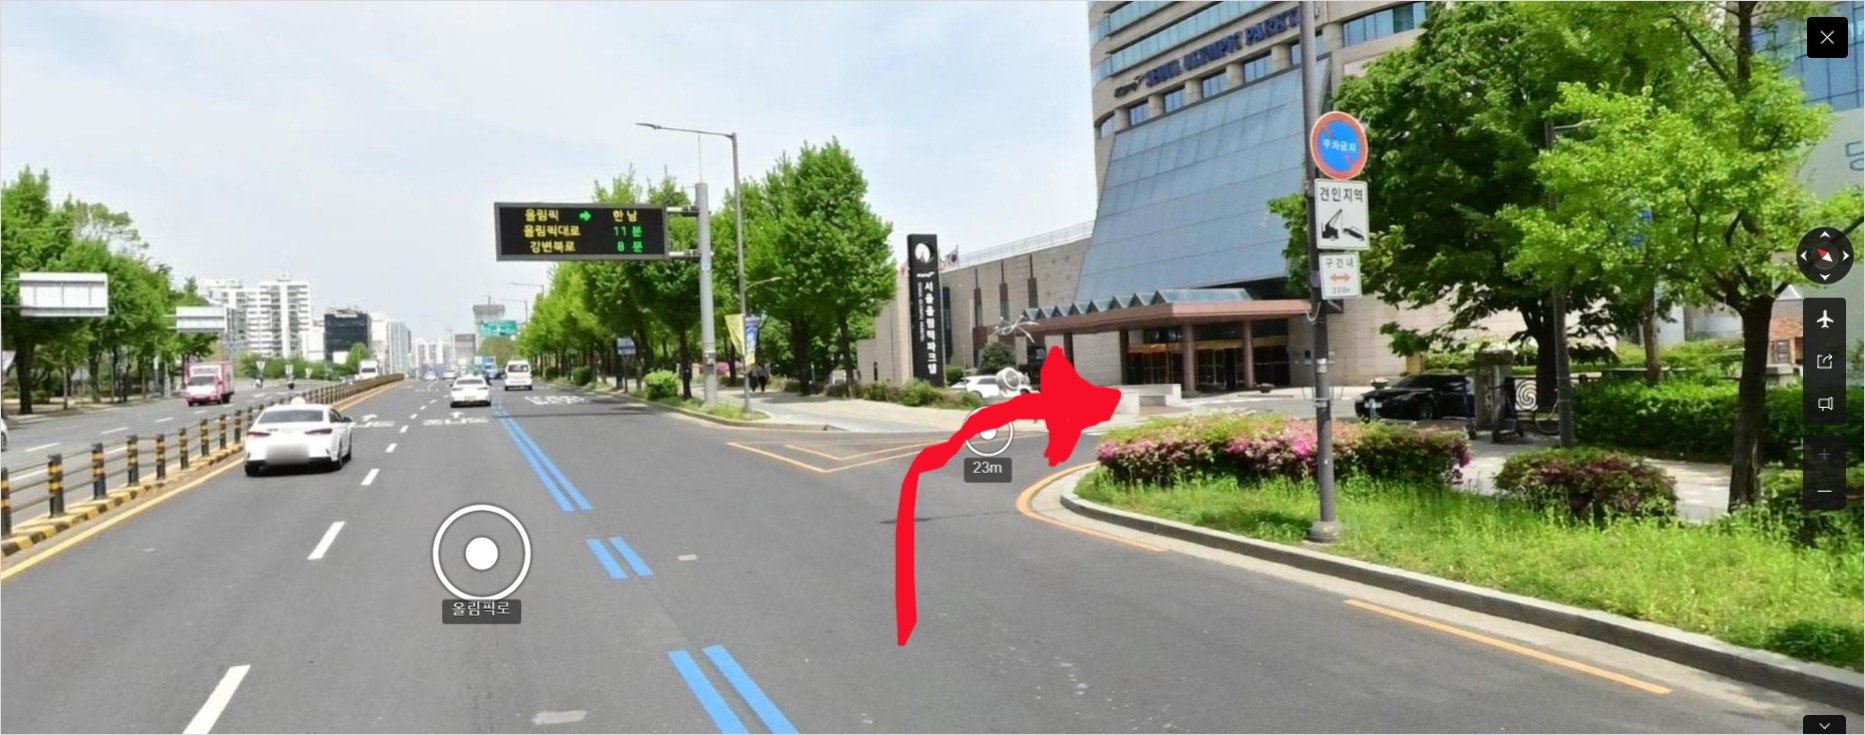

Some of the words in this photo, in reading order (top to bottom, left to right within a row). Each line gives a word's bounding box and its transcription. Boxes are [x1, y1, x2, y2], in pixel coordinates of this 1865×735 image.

[1323, 139, 1356, 152] 주차금지
[1320, 187, 1363, 202] 견인지역
[525, 208, 559, 222] 올림픽
[523, 224, 581, 237] 올림픽대로
[613, 226, 626, 237] 11
[632, 225, 642, 237] 분
[530, 240, 576, 253] 강변북로
[617, 241, 625, 252] 8
[632, 241, 643, 253] 분
[924, 281, 937, 375] 서울올림픽파크텔
